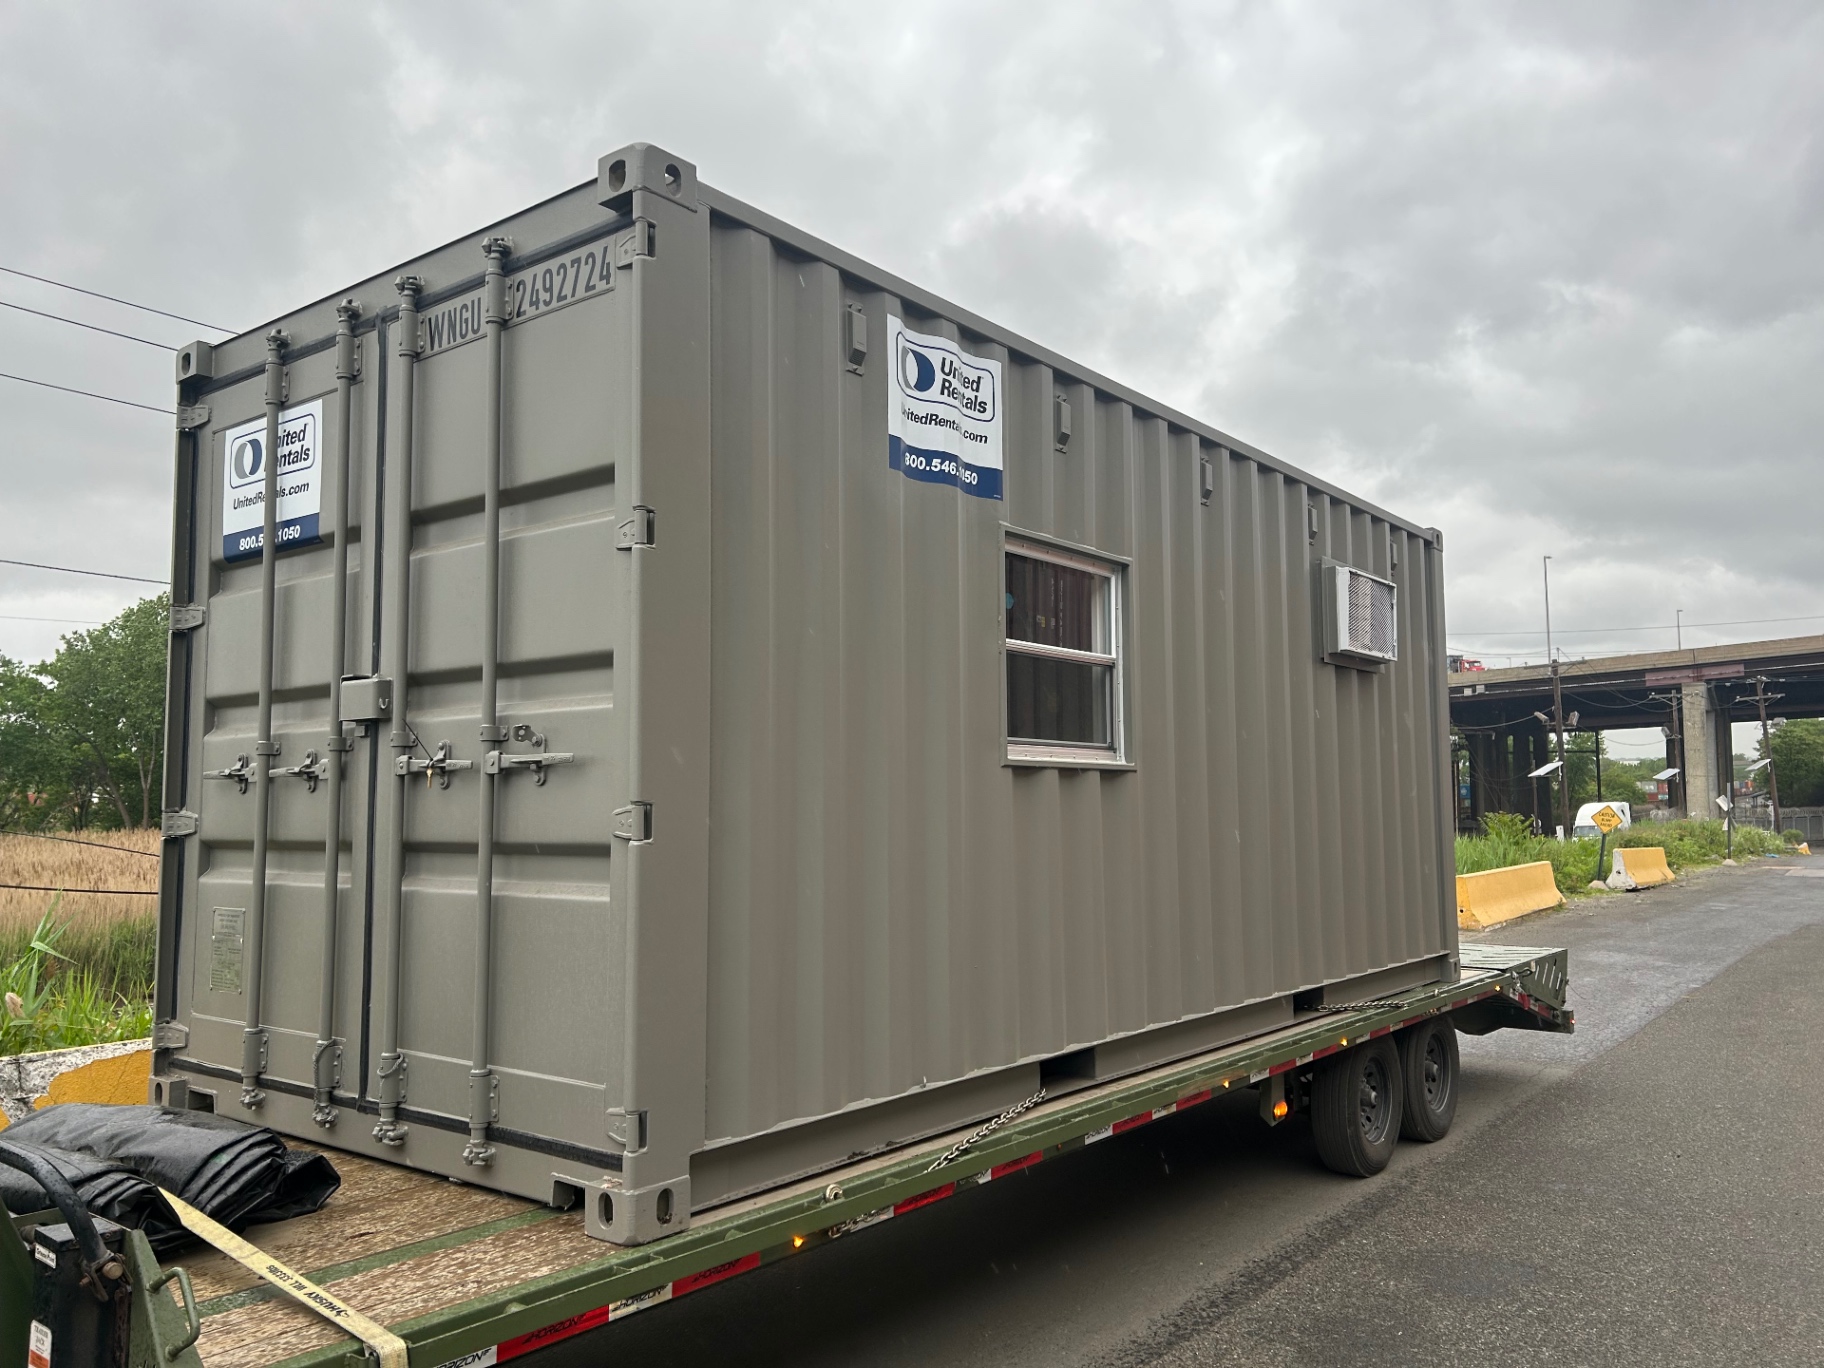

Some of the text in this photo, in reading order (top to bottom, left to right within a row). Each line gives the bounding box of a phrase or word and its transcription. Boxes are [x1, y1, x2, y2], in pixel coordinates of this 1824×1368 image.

[428, 246, 612, 351] WNGU 2492724
[275, 423, 307, 449] ited
[266, 444, 310, 471] ntals
[233, 482, 310, 510] UnitedReals.com
[239, 525, 301, 551] 800.5.1050
[303, 1292, 341, 1312] HUSKY
[527, 1314, 583, 1341] HORIZON
[437, 1350, 487, 1368] RIZON
